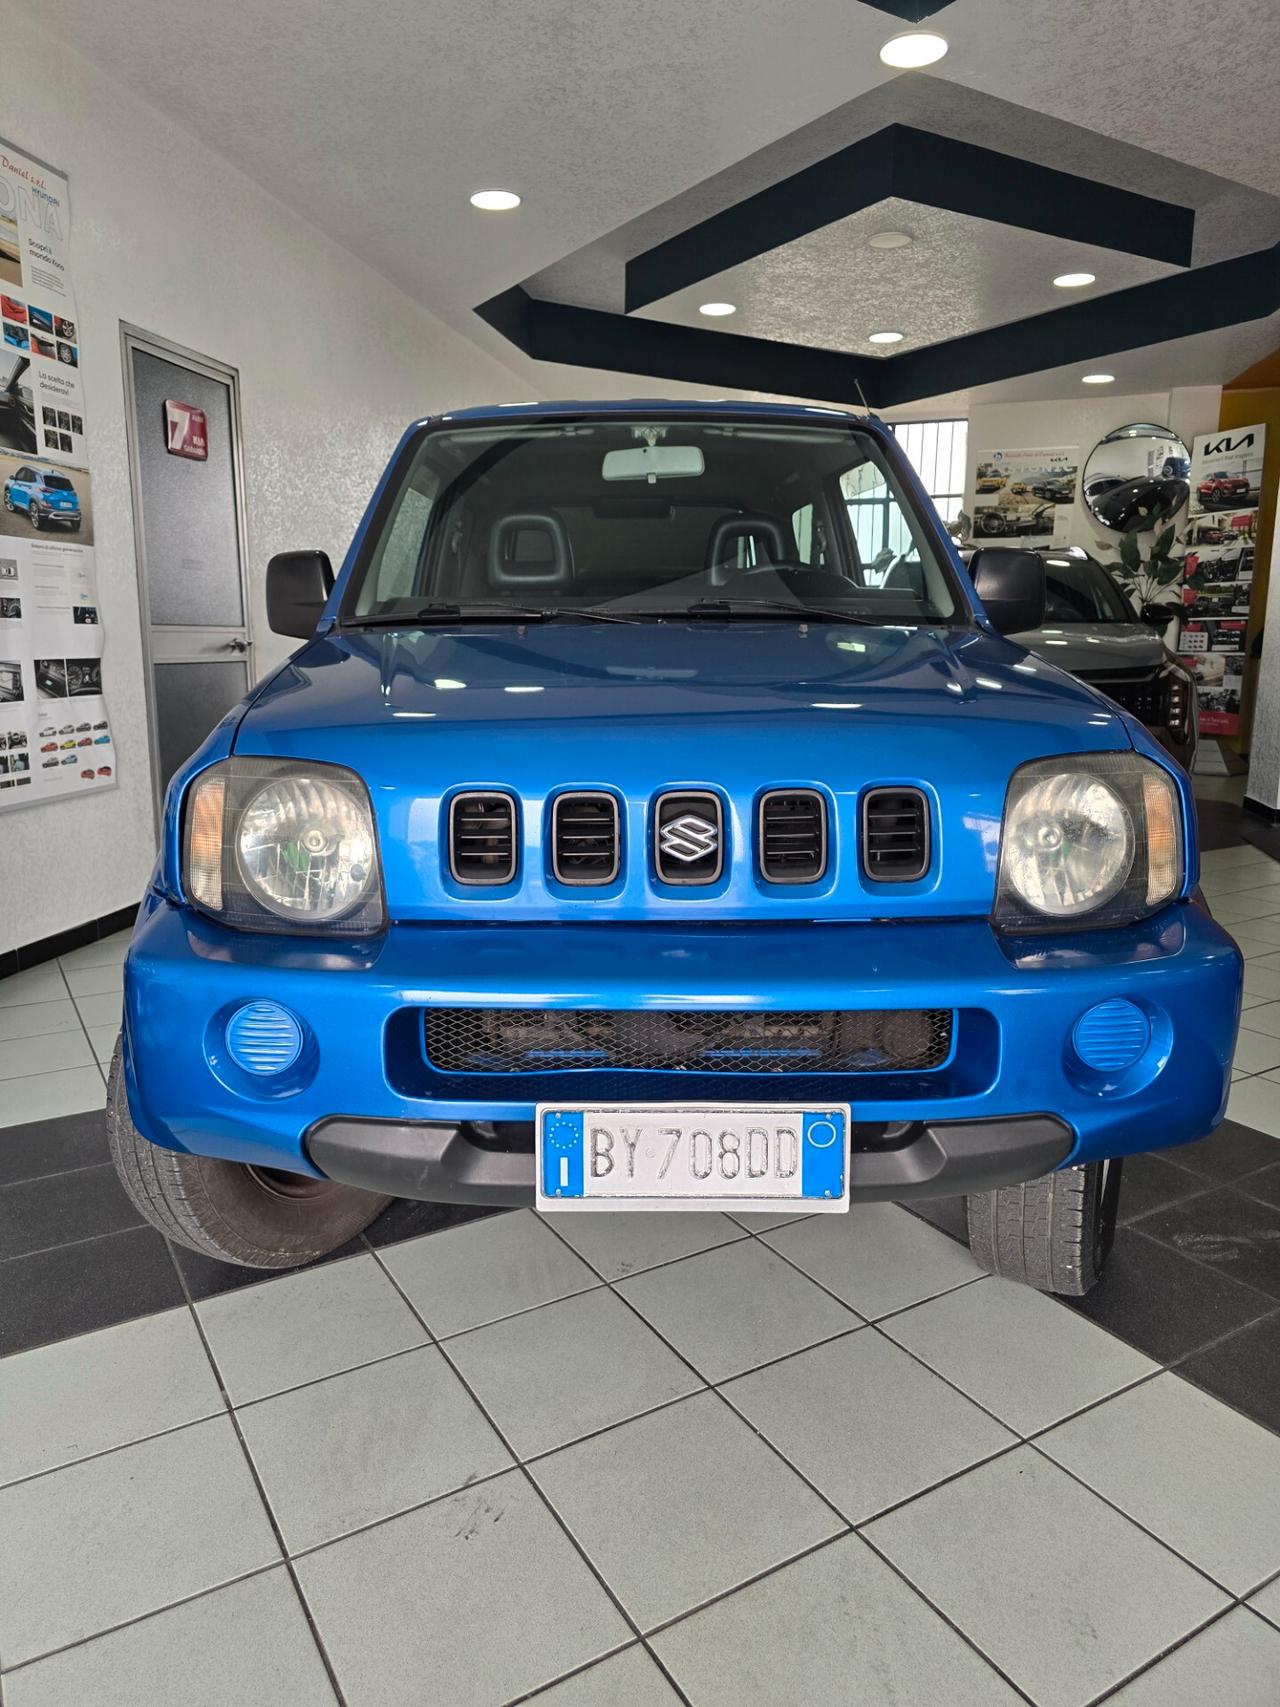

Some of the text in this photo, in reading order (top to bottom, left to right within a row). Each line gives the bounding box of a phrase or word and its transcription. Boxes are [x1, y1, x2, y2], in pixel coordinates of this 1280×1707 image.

[1203, 432, 1255, 456] KIA
[590, 1125, 798, 1181] BY 708DD
